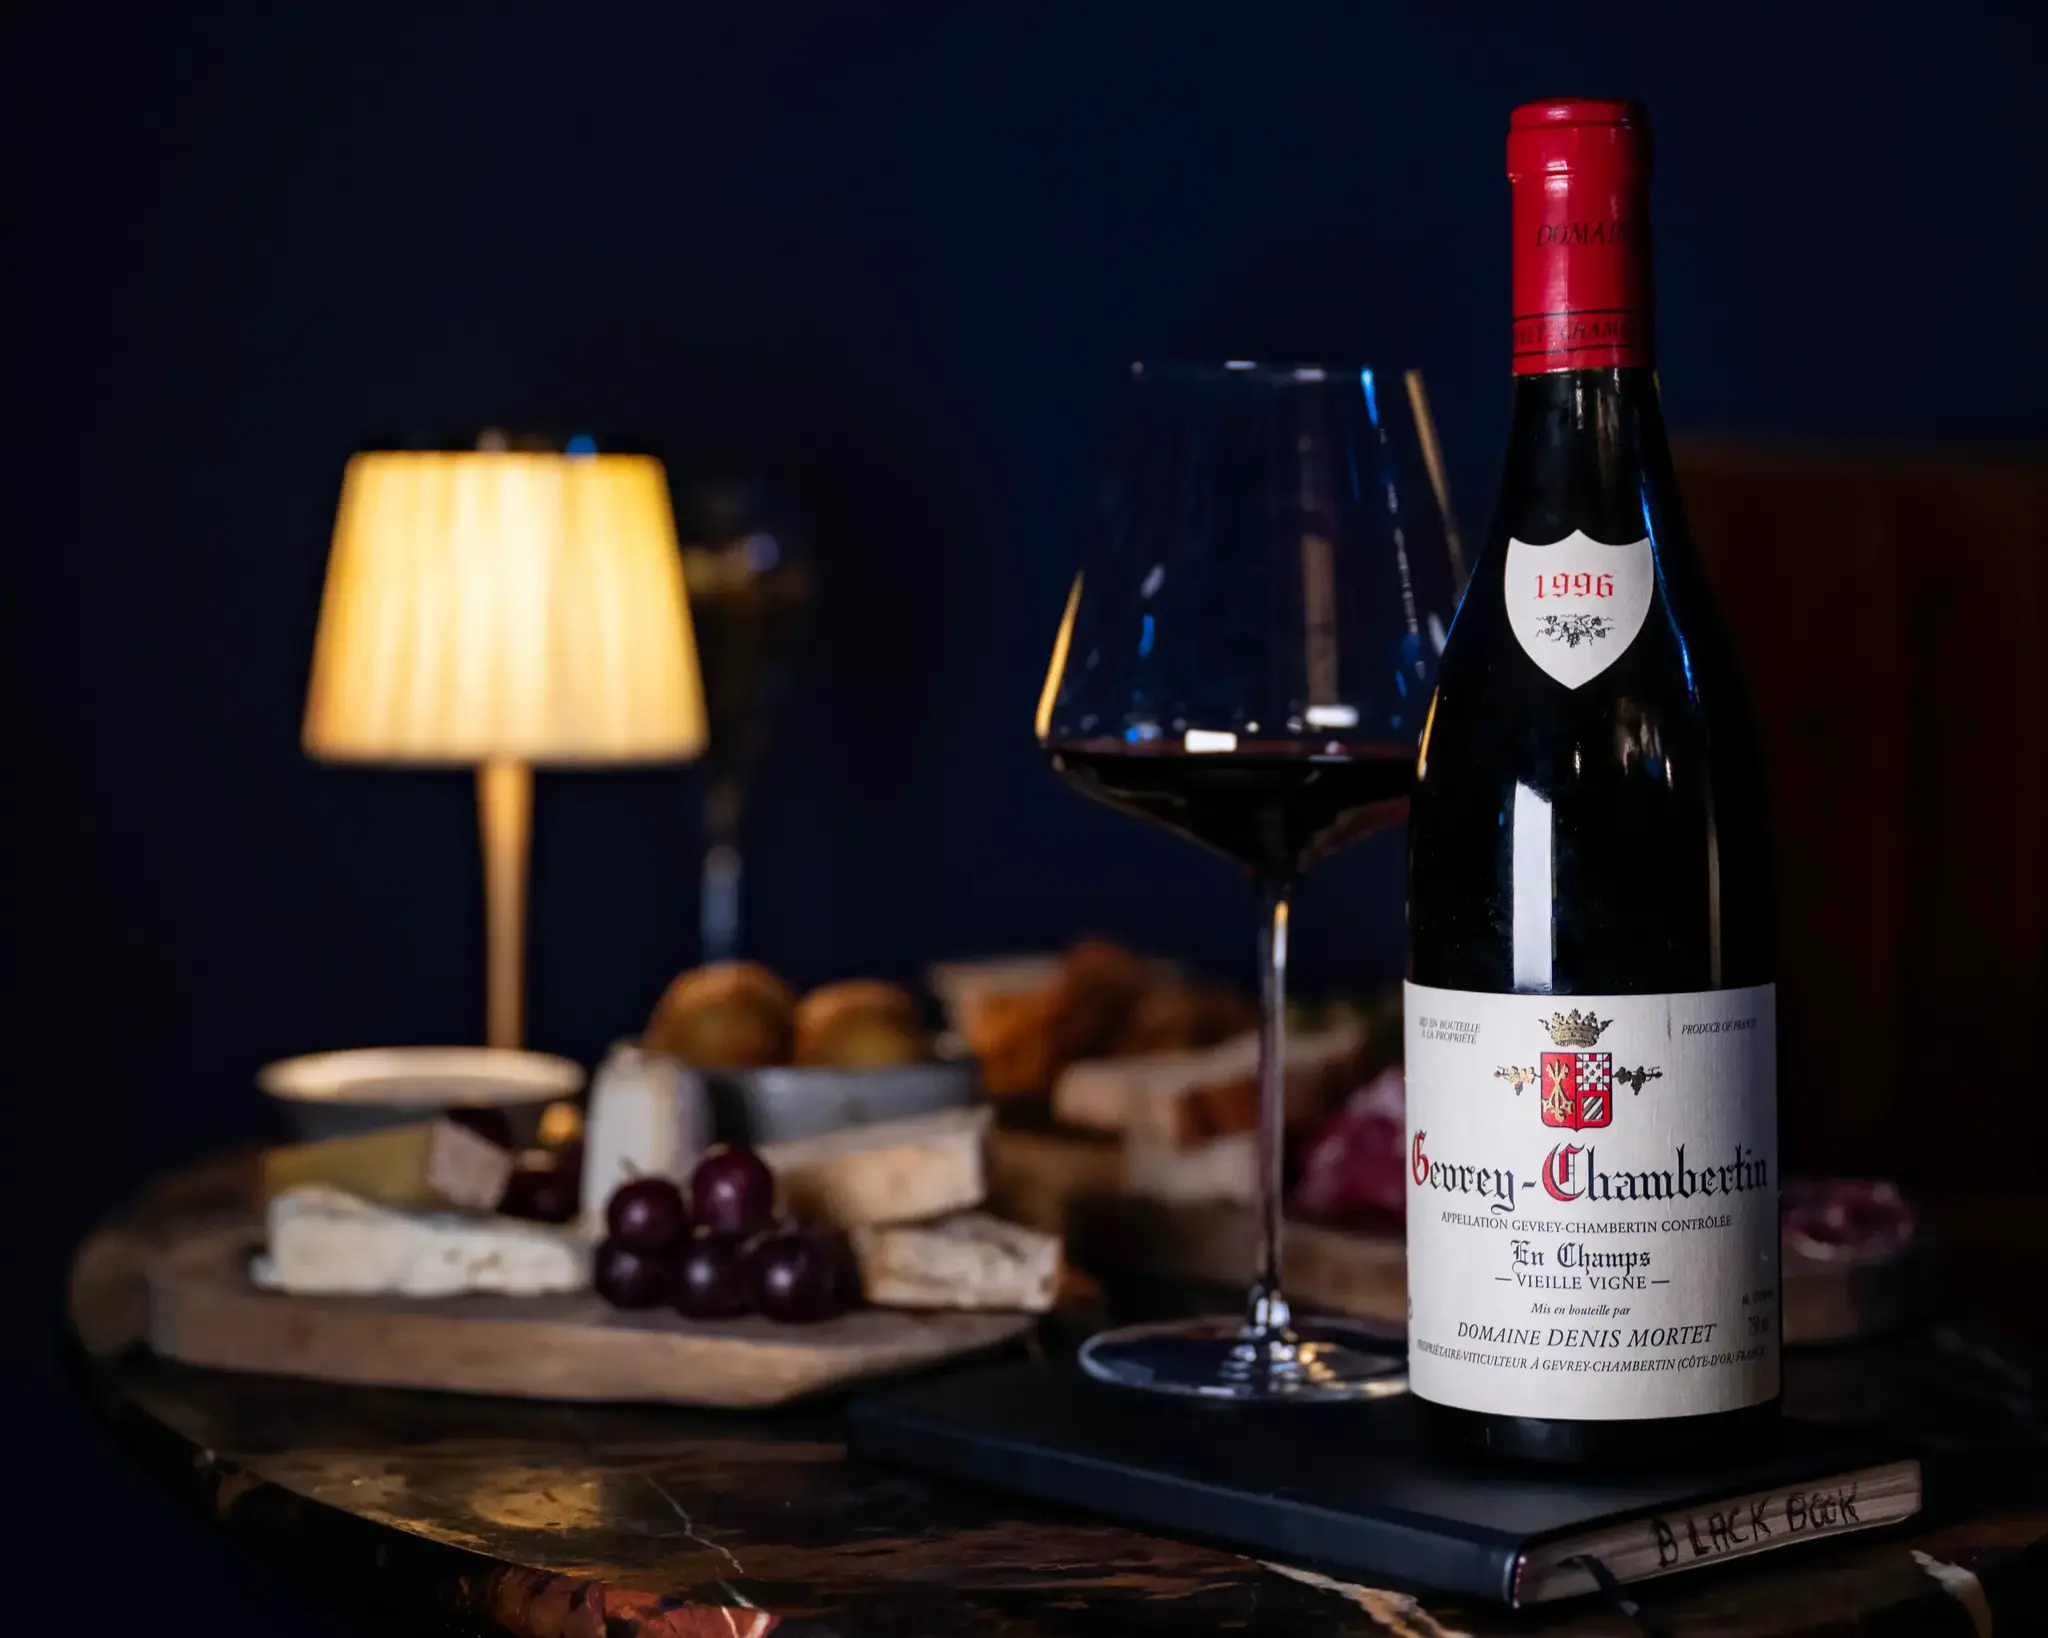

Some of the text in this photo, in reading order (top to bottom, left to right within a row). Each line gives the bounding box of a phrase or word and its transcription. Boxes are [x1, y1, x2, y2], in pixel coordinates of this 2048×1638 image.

[1534, 573, 1614, 600] 1996
[1439, 1020, 1480, 1033] BOUTEILLE
[1681, 1021, 1720, 1035] PRODUCE
[1721, 1021, 1732, 1032] OF
[1412, 1130, 1768, 1215] Gevrey-Chambertin
[1441, 1211, 1732, 1234] APPELLATION GEVREY-CHAMBERTIN CONTRÔLÉE
[1510, 1239, 1651, 1276] En Champs
[1516, 1274, 1647, 1290] VIEILLE VIGNE
[1530, 1302, 1632, 1318] Mis en bouteille par
[1457, 1321, 1717, 1348] DOMAINE DENIS MORTET
[1529, 1357, 1540, 1370] À
[1542, 1358, 1676, 1373] GEVREY-CHAMBERTIN
[1677, 1352, 1735, 1371] (CÔTE-D'OR)
[1654, 1482, 1860, 1567] BLACK BOOK
